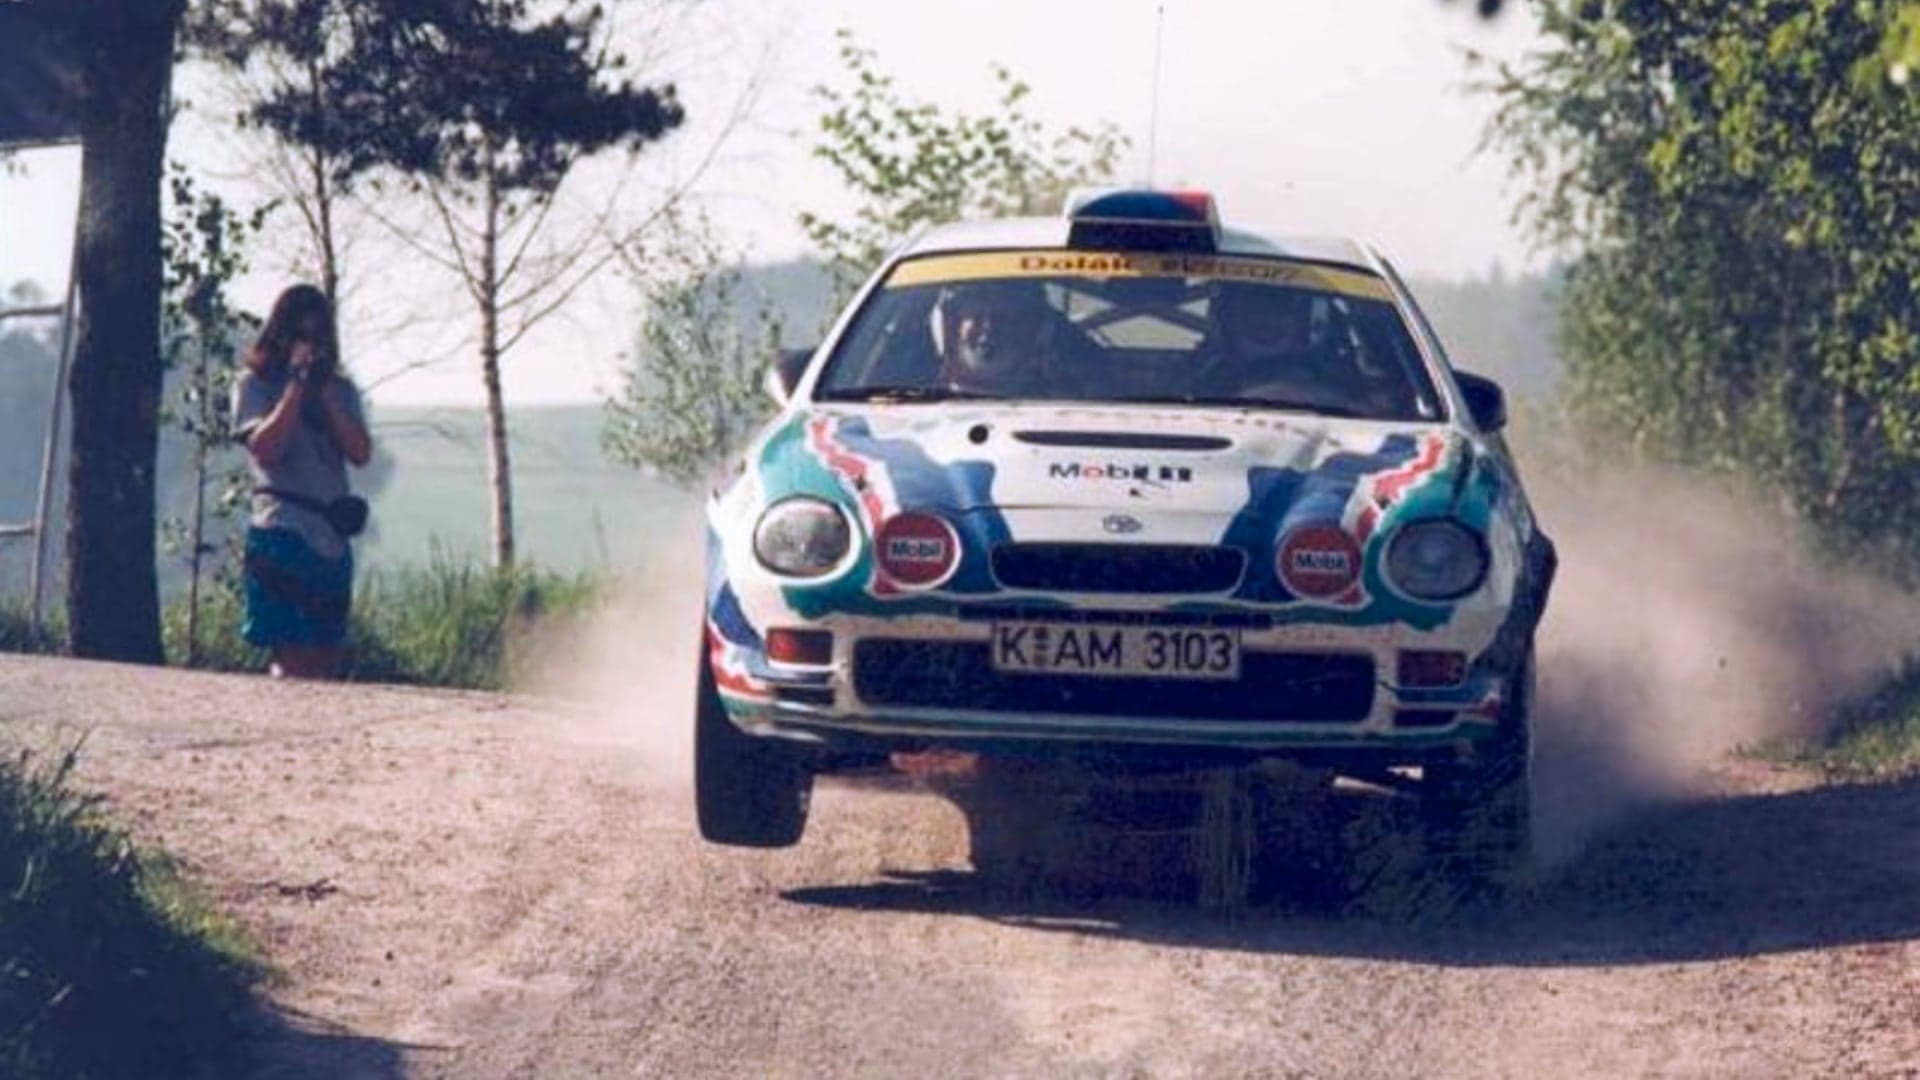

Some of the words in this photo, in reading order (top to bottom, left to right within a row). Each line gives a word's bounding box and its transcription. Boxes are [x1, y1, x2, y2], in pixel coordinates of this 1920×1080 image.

[890, 540, 941, 557] Mobil
[1295, 552, 1346, 569] Mobil
[1143, 632, 1233, 671] 3103
